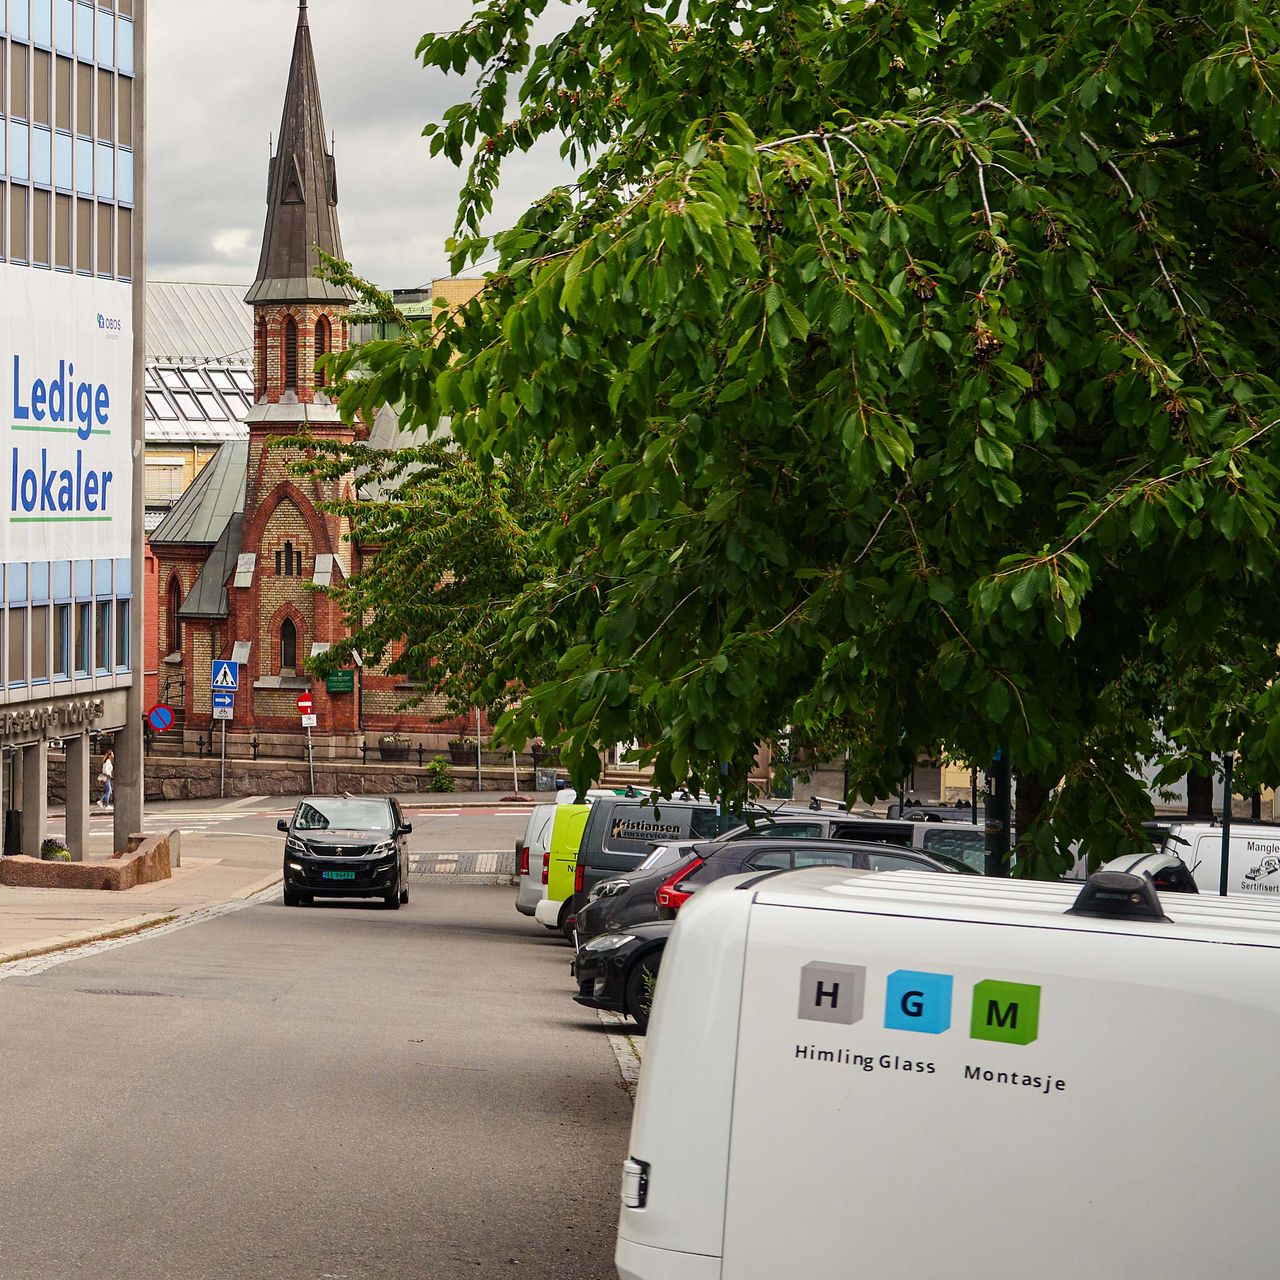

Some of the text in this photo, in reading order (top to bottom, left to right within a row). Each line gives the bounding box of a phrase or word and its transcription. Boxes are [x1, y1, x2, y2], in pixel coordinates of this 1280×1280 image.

[106, 318, 121, 330] OBOS
[13, 354, 110, 441] Ledige
[11, 447, 113, 512] lokaler
[611, 818, 680, 837] Kristiansen
[1247, 841, 1280, 855] Mangle
[1241, 881, 1280, 892] Sertifisert
[814, 980, 1019, 1029] H G M
[795, 1044, 1066, 1094] Himling Glass Montasje
